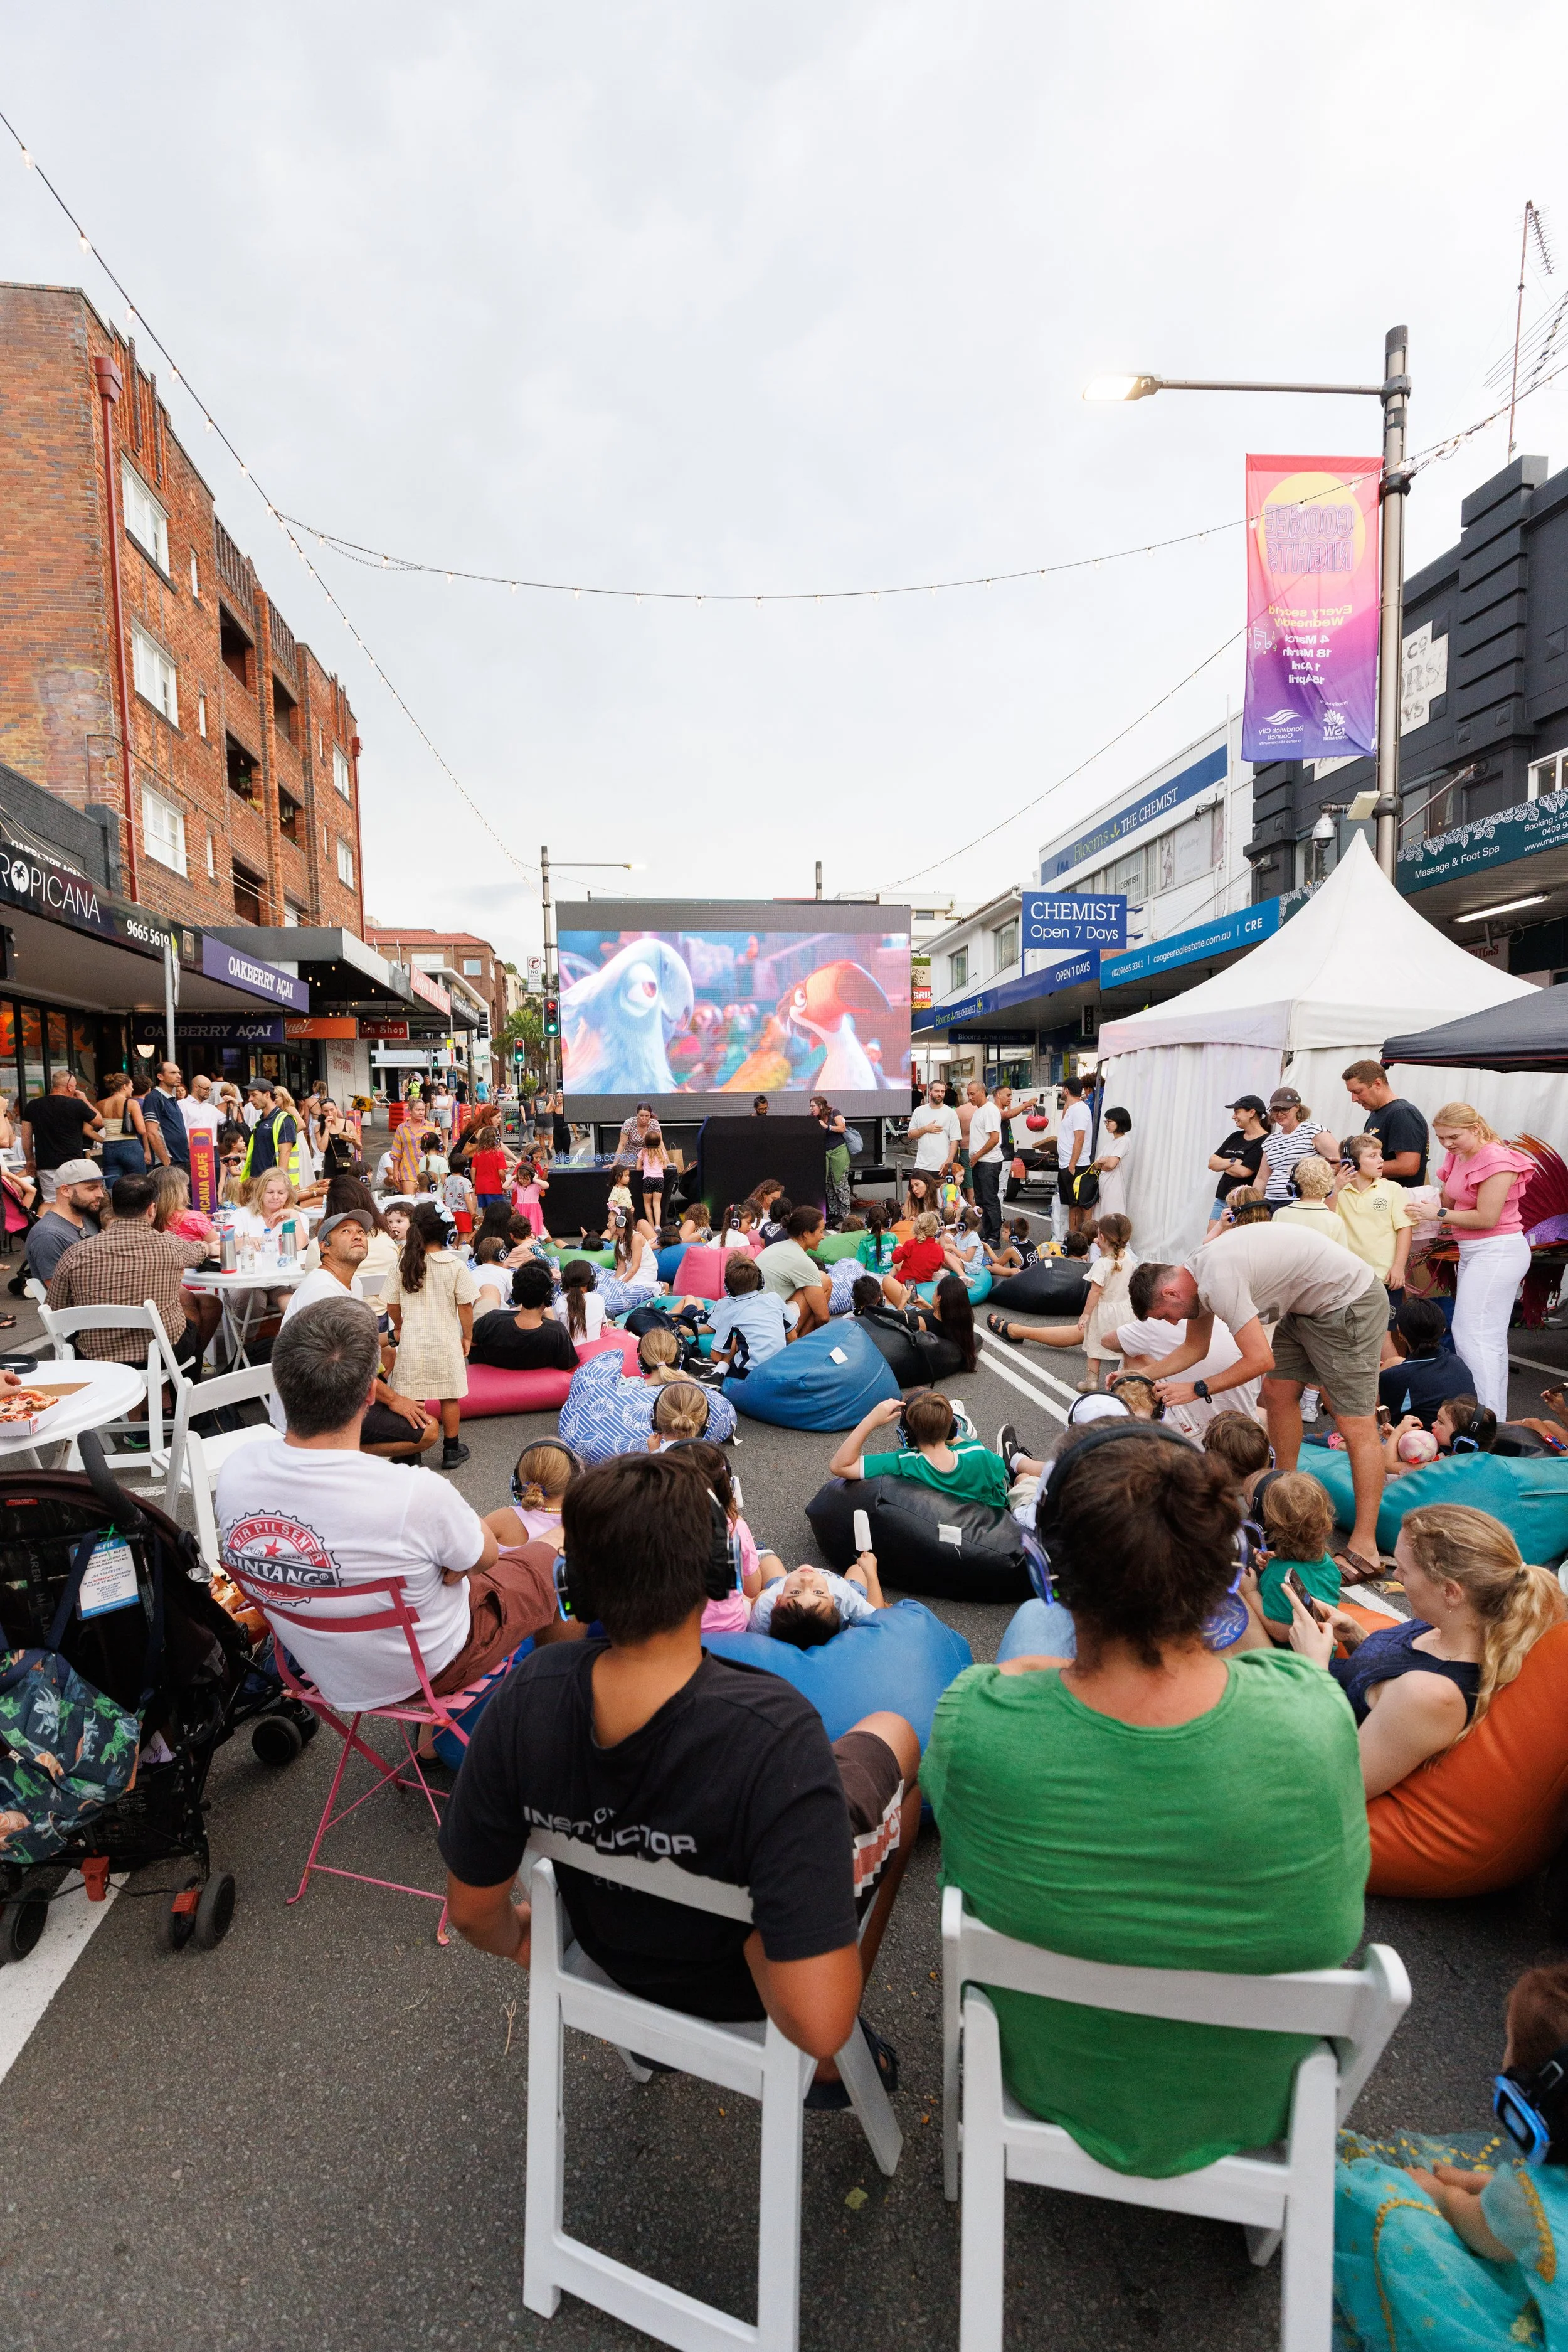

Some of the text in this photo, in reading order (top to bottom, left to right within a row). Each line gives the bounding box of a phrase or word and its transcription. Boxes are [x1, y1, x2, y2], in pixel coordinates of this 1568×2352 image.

[1073, 787, 1179, 861] Blooms THE CHEMIST
[1524, 817, 1554, 833] Booking
[1542, 824, 1560, 836] 0409
[1415, 844, 1500, 879] Massage & Foot Spa
[1120, 874, 1140, 890] DENTIST
[1030, 902, 1120, 921] CHEMIST
[127, 919, 148, 942] 9665
[1030, 924, 1118, 942] Open 7 Days
[1244, 917, 1263, 932] CRE
[1131, 960, 1144, 971] 3341
[1153, 930, 1231, 964] coogeerealestate.com.au
[228, 956, 294, 1000] OAKBERRY AÇAI
[1056, 960, 1091, 982] OPEN 7 DAYS
[414, 967, 448, 1014] Coogee Fish Shop
[935, 1014, 951, 1026] Blooms
[961, 1004, 976, 1017] CHEMIST
[144, 1025, 231, 1037] OABERRY
[235, 1024, 272, 1039] AÇAI
[379, 1025, 405, 1035] Shop
[194, 1152, 209, 1178] CAFÉ
[94, 1541, 114, 1552] ALFIE
[233, 1522, 323, 1563] BIR PILSENER
[245, 1546, 264, 1557] TRADE
[523, 1806, 697, 1854] INSTUCTOR
